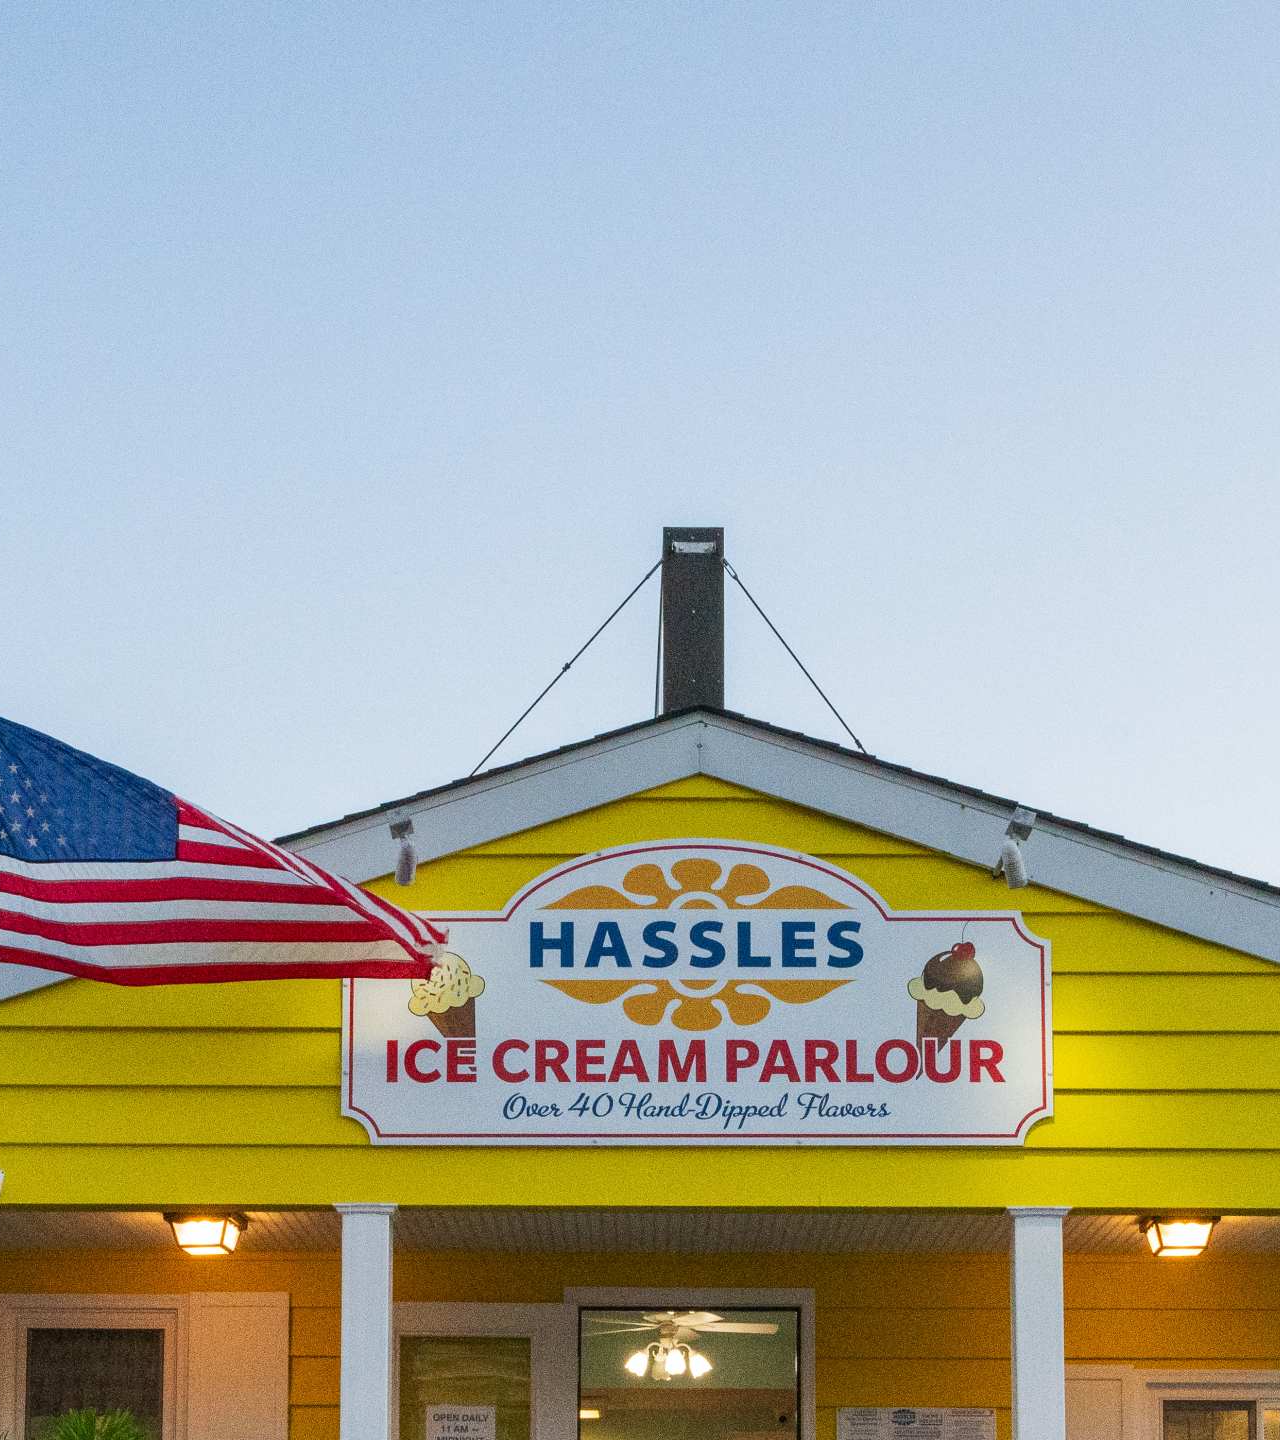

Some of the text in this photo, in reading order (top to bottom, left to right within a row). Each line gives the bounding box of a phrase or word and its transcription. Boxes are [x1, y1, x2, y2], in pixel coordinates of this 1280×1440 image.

[529, 920, 865, 969] HASSLES
[386, 1039, 1005, 1083] ICE CREAM PARLOUR
[503, 1091, 892, 1131] Over 40 Hand-Dipped Flavors
[432, 1413, 489, 1422] OPEN DAILY
